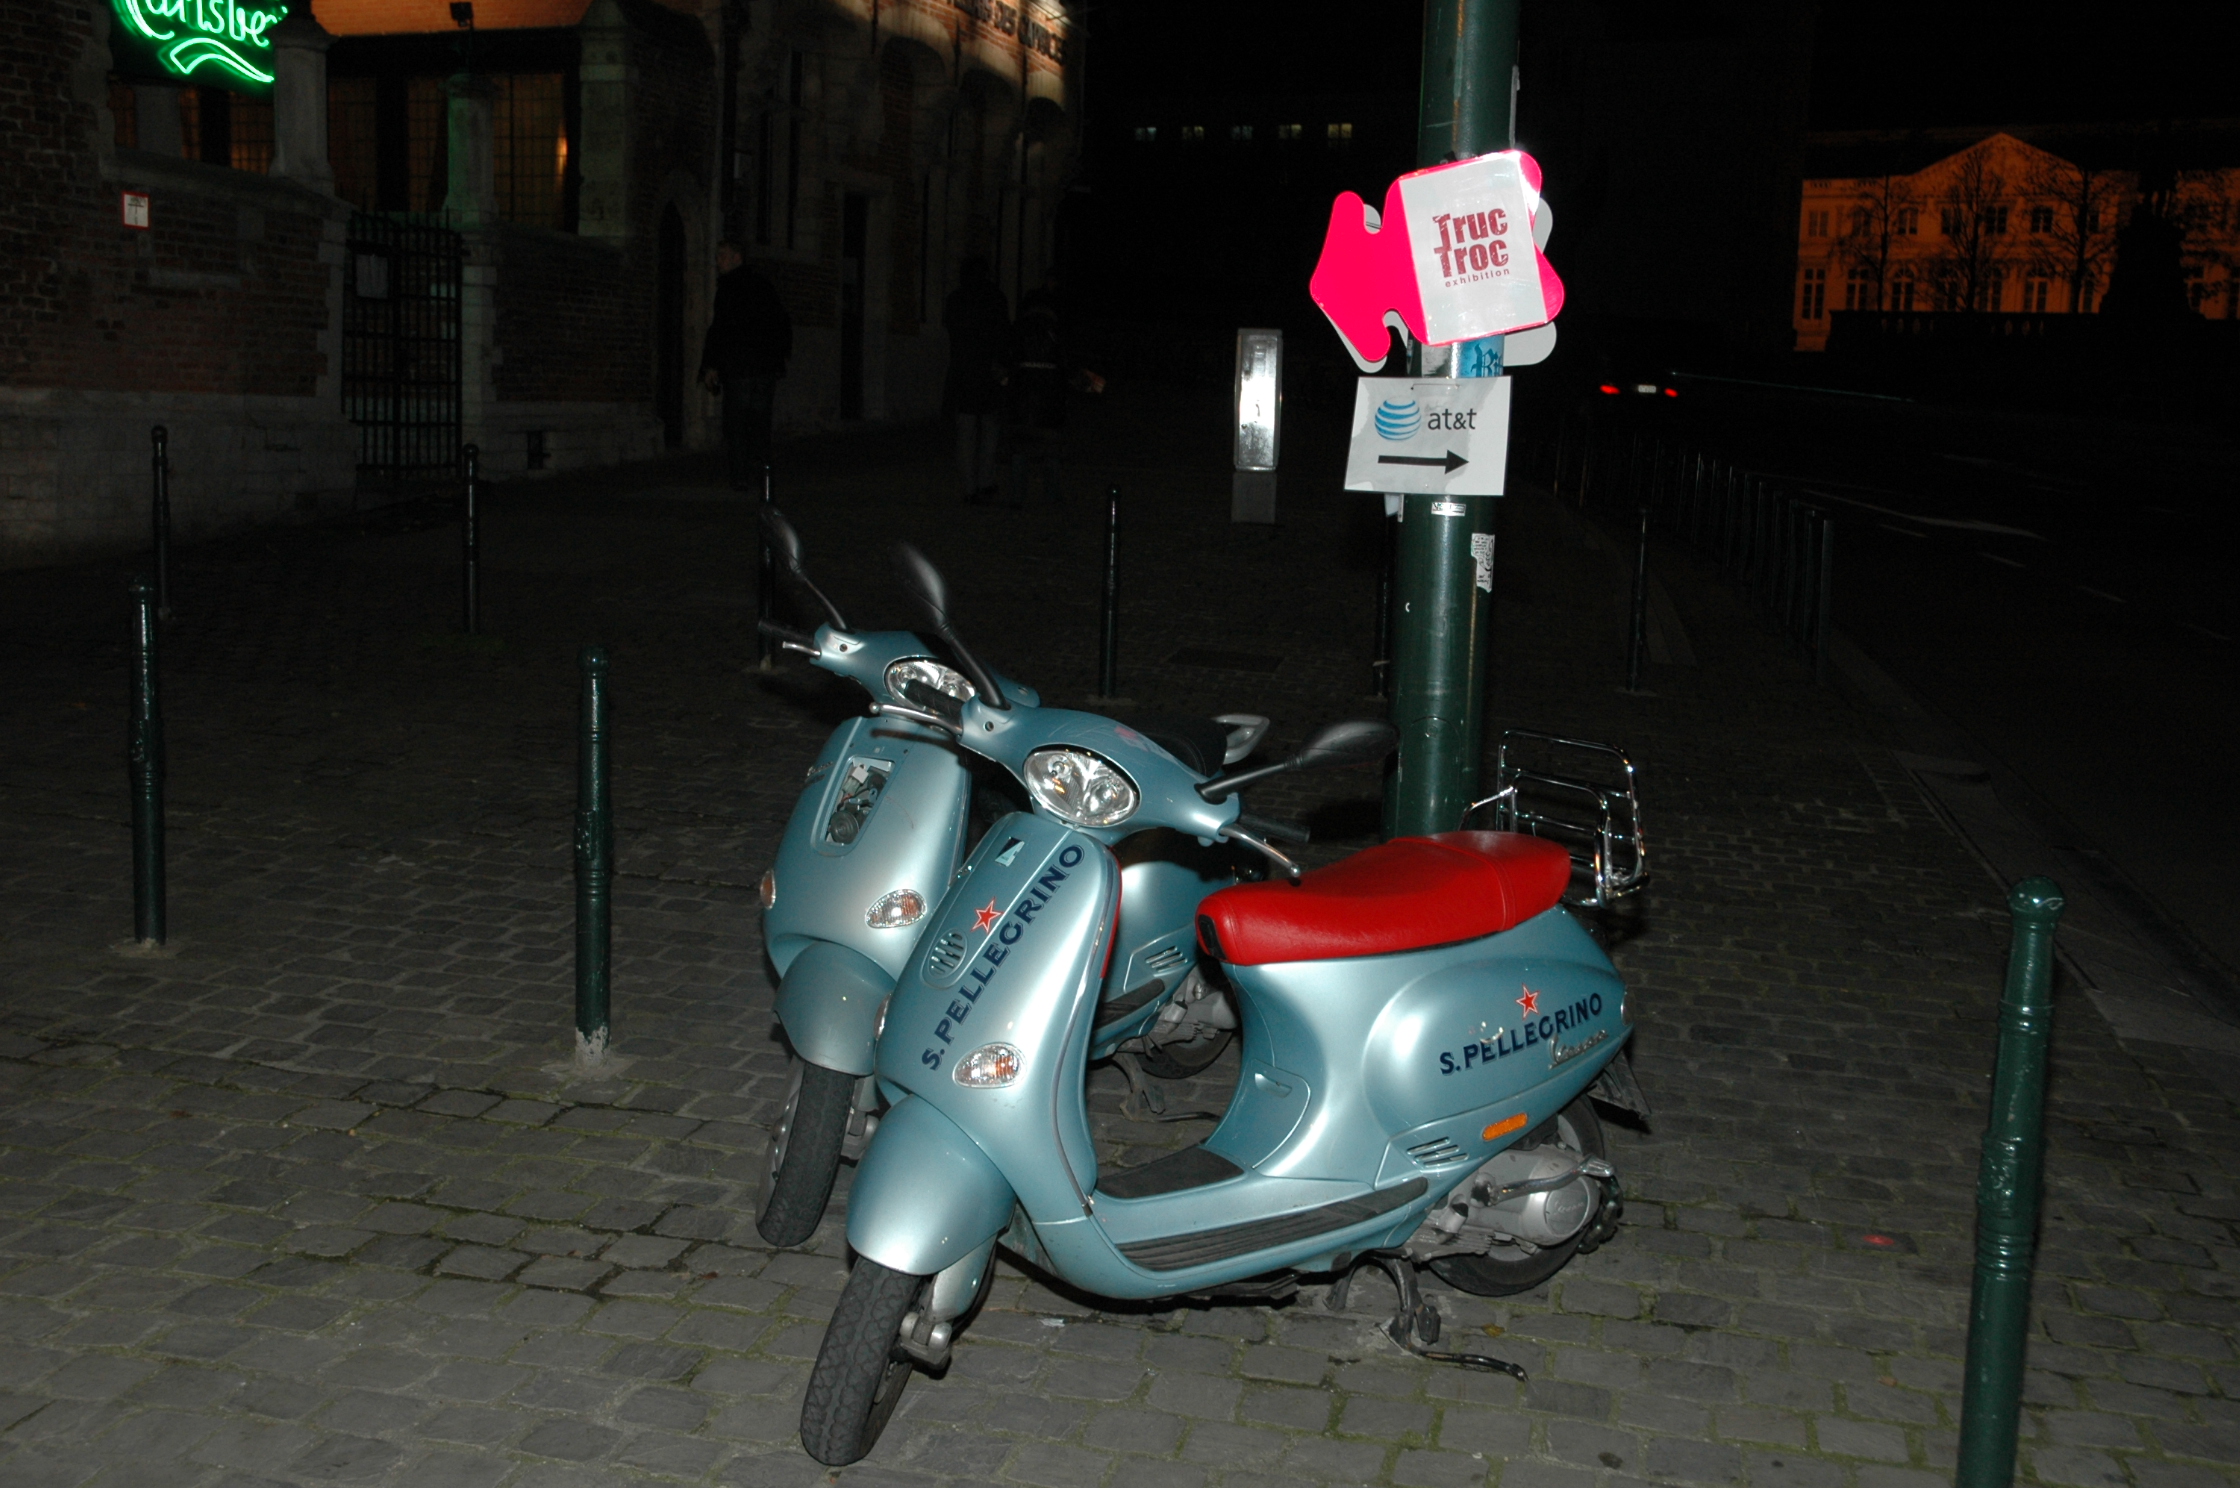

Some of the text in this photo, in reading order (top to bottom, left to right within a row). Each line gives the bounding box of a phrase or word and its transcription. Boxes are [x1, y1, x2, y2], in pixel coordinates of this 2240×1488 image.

[1432, 208, 1508, 244] Truc
[1433, 240, 1509, 278] Troc
[1445, 268, 1510, 288] exhibition
[1427, 408, 1477, 430] at&t
